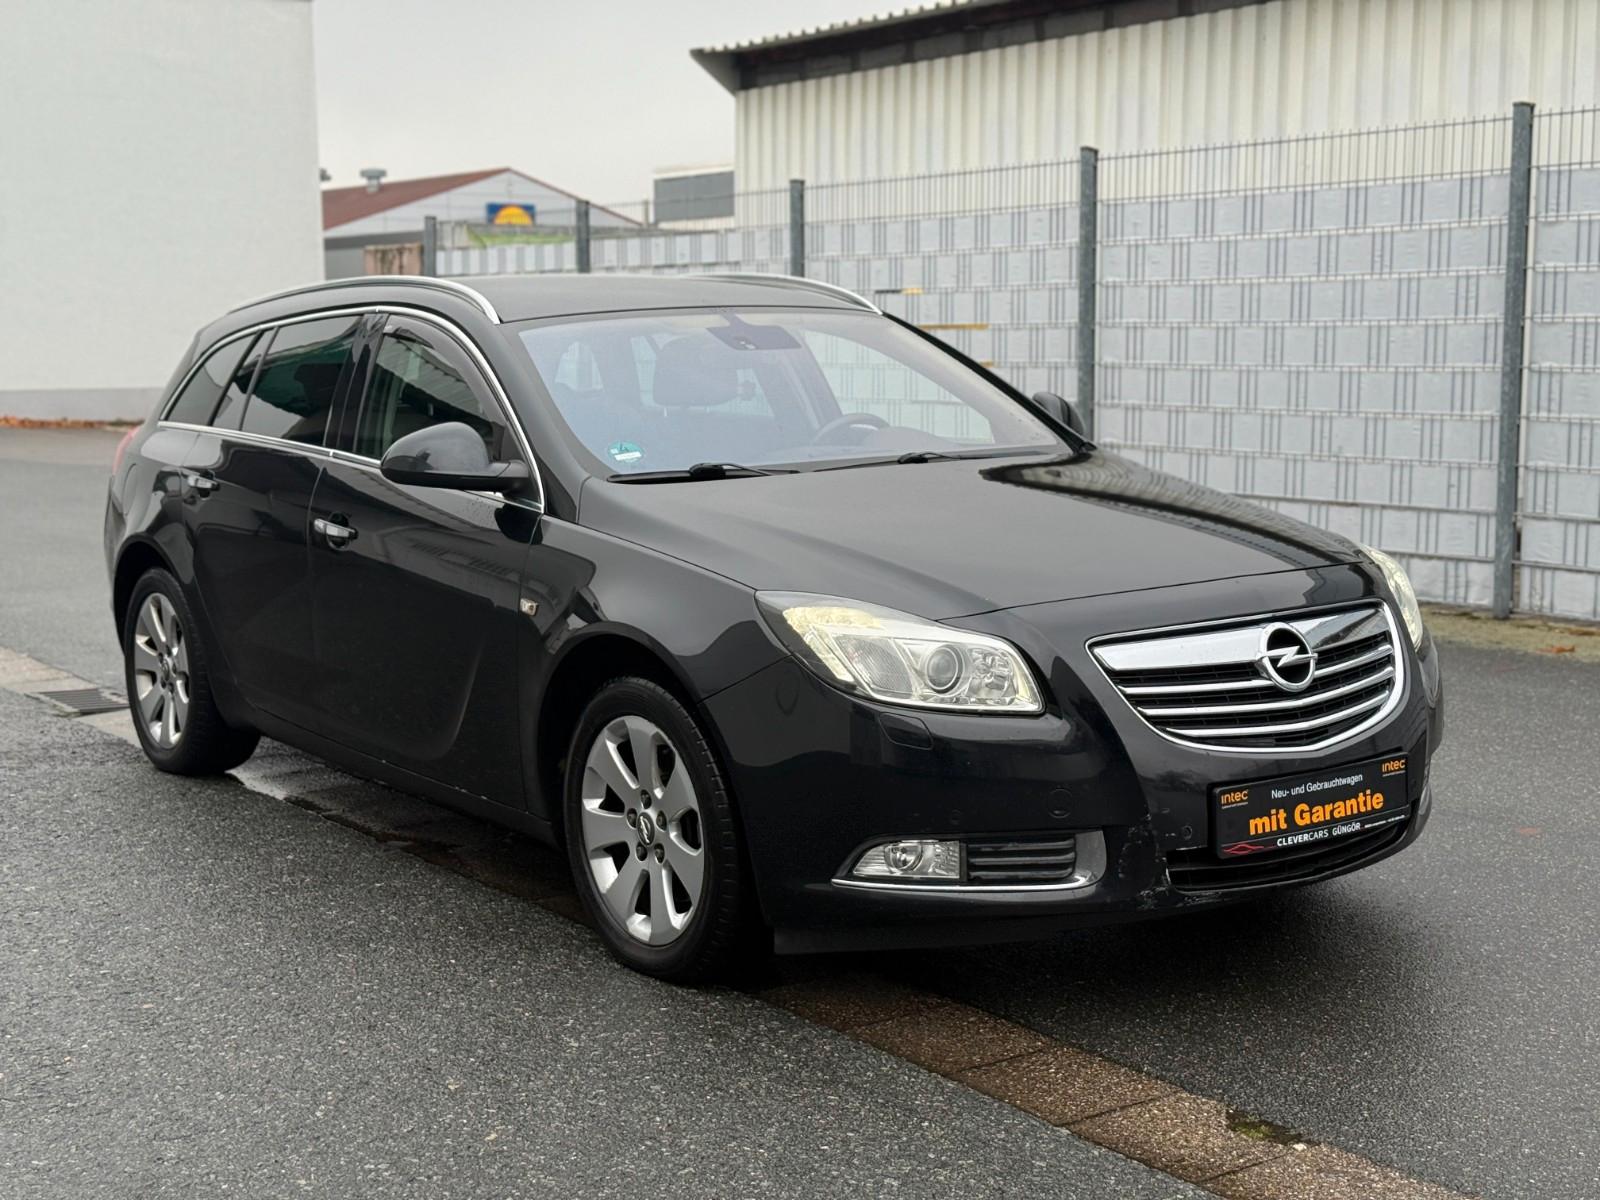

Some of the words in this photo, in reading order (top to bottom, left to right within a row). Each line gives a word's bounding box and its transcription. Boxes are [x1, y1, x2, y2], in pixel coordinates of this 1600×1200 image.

[1382, 760, 1405, 772] intec
[1221, 790, 1248, 805] intec
[1271, 789, 1289, 799] Neu-
[1291, 784, 1305, 796] und
[1306, 774, 1363, 793] Gebrauchtwagen
[1249, 808, 1287, 835] mit
[1294, 789, 1384, 826] Garantie
[1276, 829, 1329, 847] CLEVERCARS
[1332, 822, 1361, 836] GÜNGÖR
